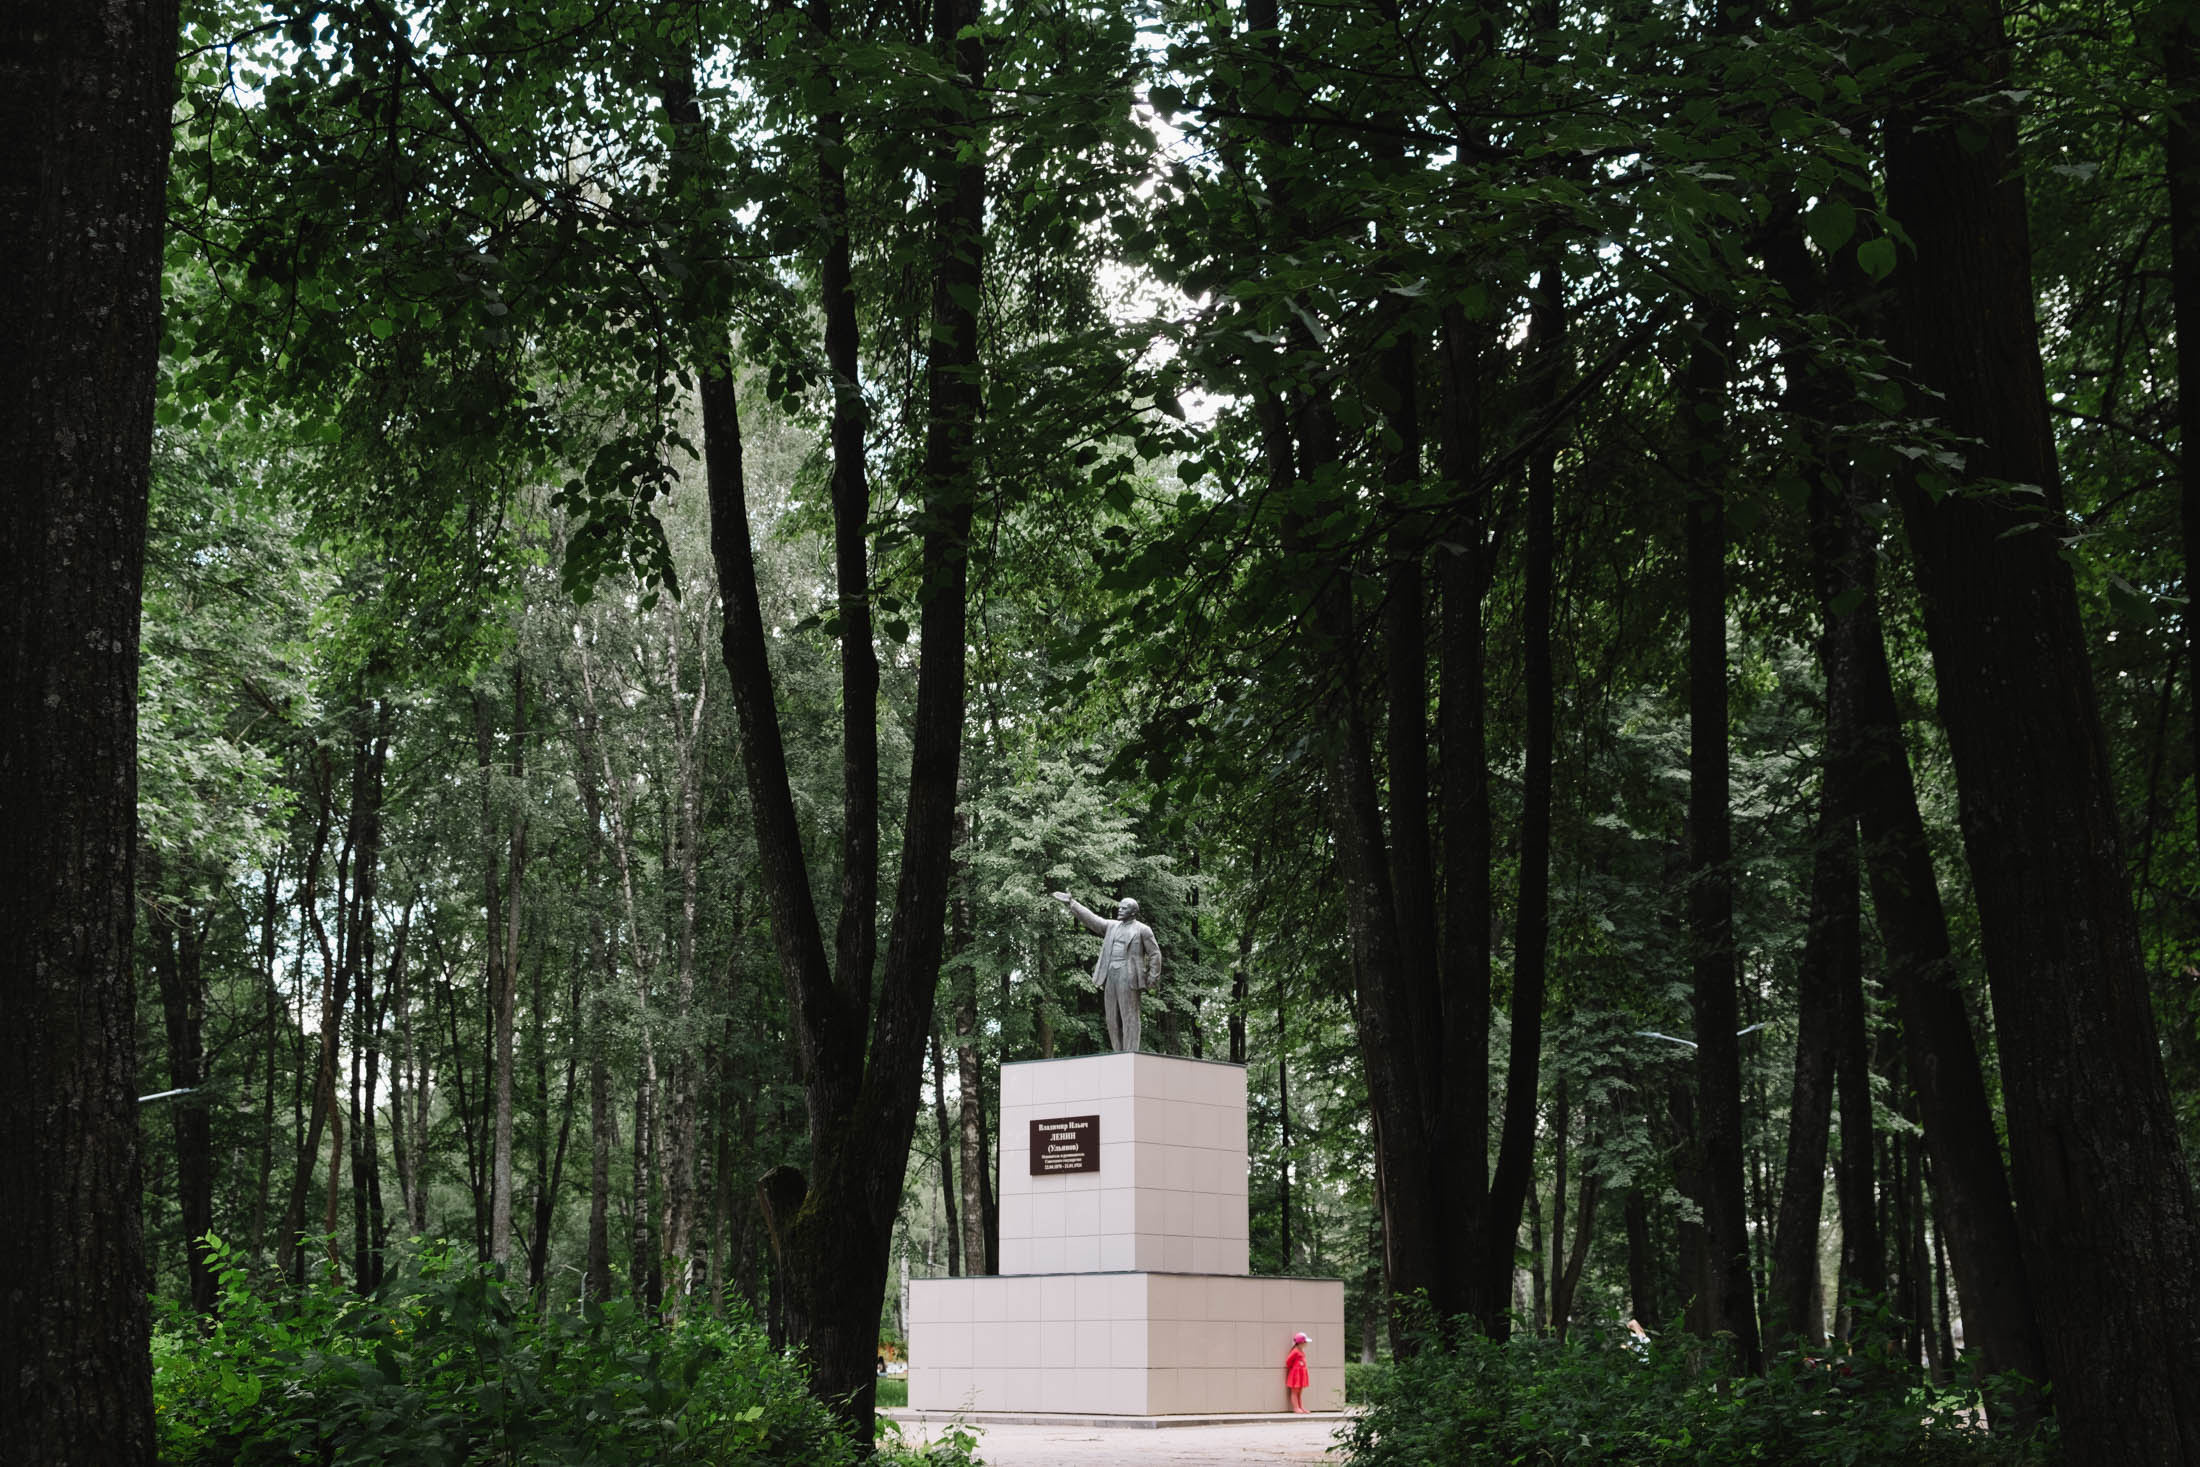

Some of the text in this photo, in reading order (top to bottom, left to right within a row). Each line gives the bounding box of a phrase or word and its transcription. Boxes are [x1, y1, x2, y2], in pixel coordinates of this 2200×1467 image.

[1038, 1121, 1089, 1131] Владимир Ильич
[1050, 1132, 1076, 1141] ЛЕНИН
